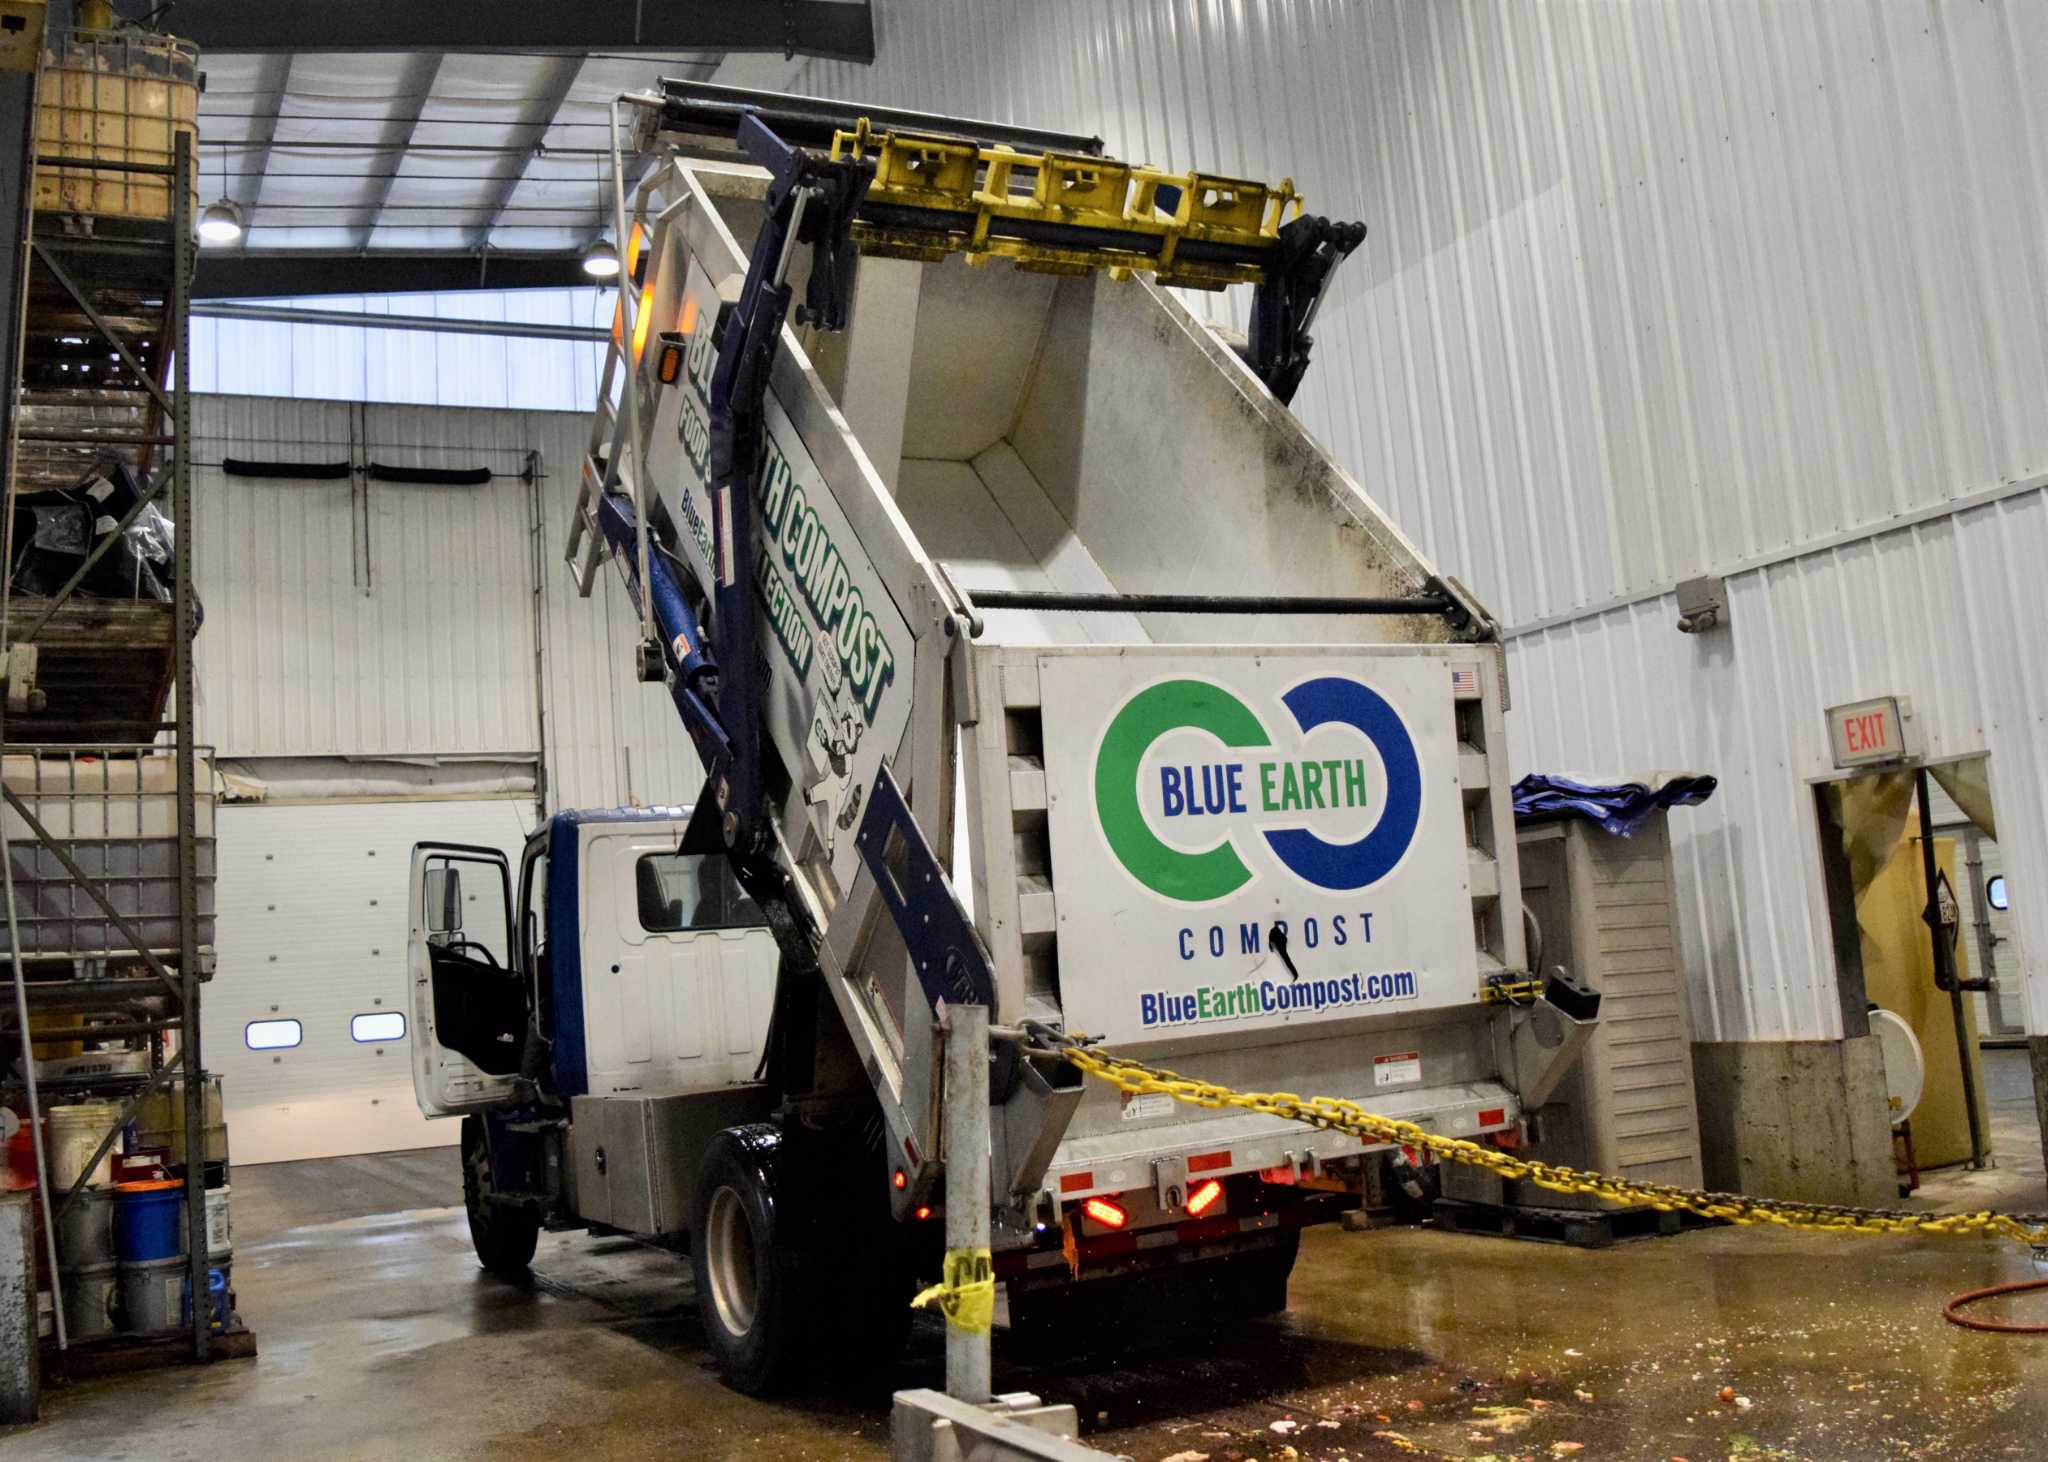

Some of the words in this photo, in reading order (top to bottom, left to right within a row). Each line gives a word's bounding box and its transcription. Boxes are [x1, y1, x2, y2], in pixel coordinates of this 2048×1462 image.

[679, 395, 708, 474] FOOD
[782, 485, 893, 722] COMPOST
[1844, 713, 1885, 752] EXIT
[1160, 764, 1247, 817] BLUE
[1259, 759, 1367, 811] EARTH
[1140, 971, 1414, 1025] BlueEarthCompost.com
